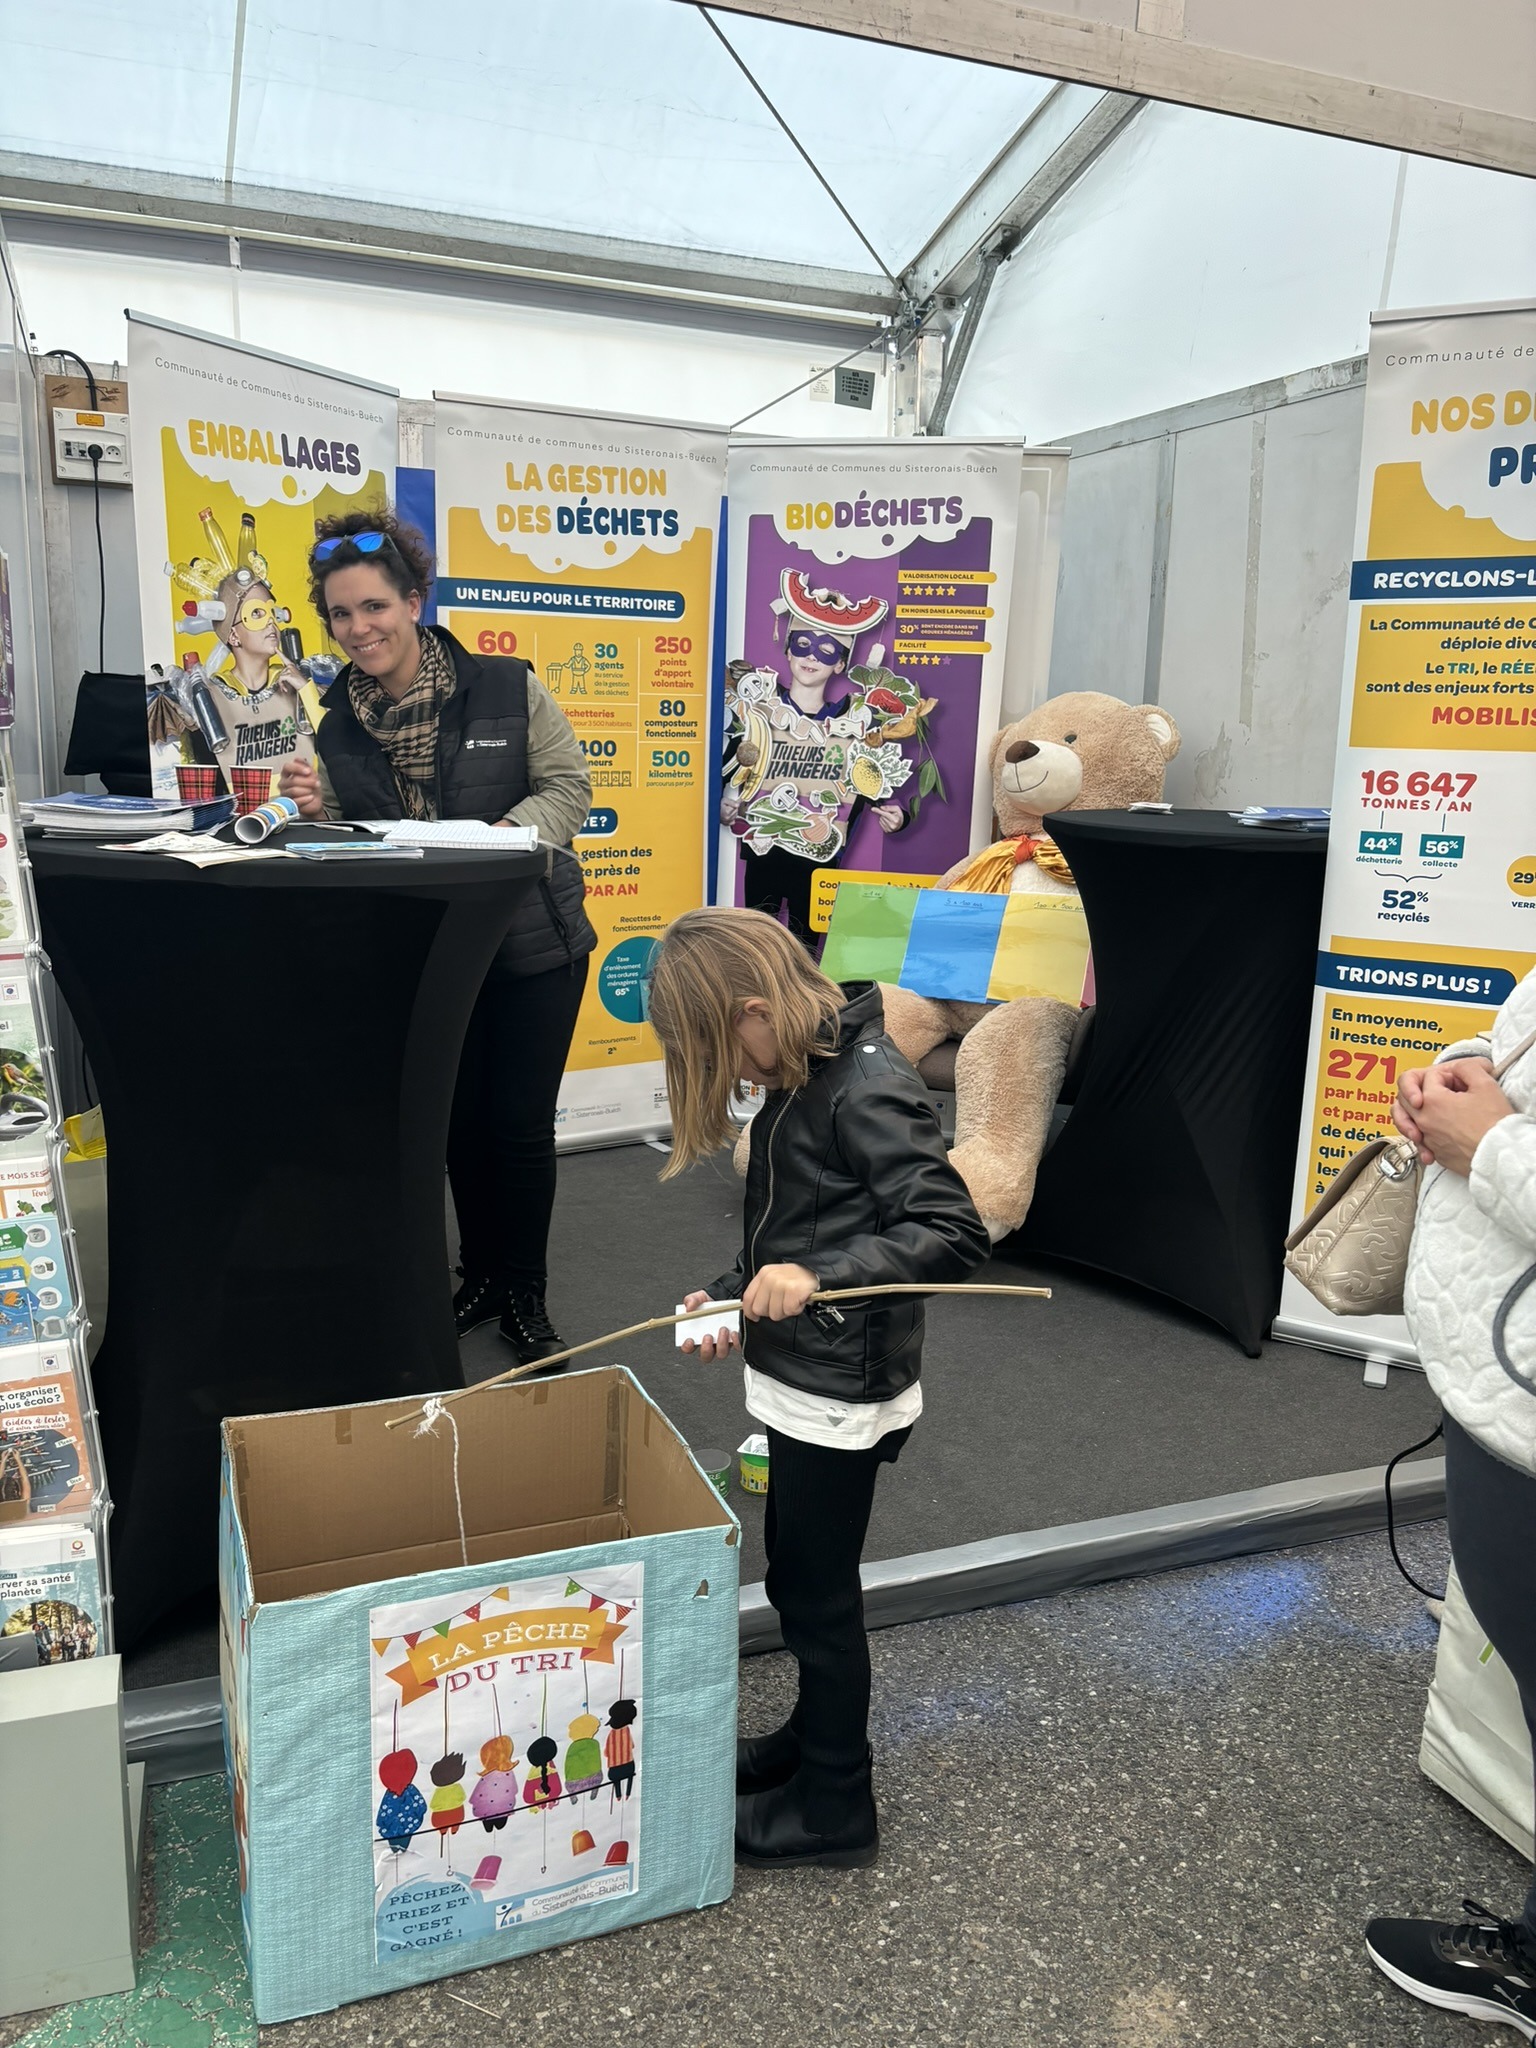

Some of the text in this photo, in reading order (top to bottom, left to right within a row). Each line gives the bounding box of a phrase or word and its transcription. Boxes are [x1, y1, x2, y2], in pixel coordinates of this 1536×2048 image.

[1385, 345, 1534, 367] Communauté de
[154, 357, 384, 424] Communauté de Communes du Sisteronais-Buëch
[1411, 393, 1496, 435] NOS
[188, 418, 361, 476] EMBALLAGES
[447, 427, 717, 464] Communauté de communes du Sisteronais-Buëch
[750, 464, 998, 474] Communauté de Communes du Sisteronais-Buëch
[505, 461, 667, 497] LA GESTION
[496, 496, 679, 537] DES DÉCHETS
[786, 490, 963, 531] BIODÉCHETS
[456, 587, 676, 612] UN ENJEU POUR LE TERRITOIRE
[900, 625, 919, 634] 30%
[1370, 617, 1525, 631] La Communauté de
[477, 630, 517, 655] 60
[654, 636, 692, 655] 250
[1441, 637, 1502, 652] déploie
[594, 643, 618, 659] 30
[594, 662, 625, 671] agents
[660, 659, 687, 667] points
[1426, 659, 1536, 676] Le TRI, le RÉE
[654, 669, 692, 679] d'apport
[651, 680, 694, 689] volontaire
[1366, 681, 1534, 696] sont des enjeux forts
[660, 700, 686, 716] 80
[645, 720, 698, 728] composteurs
[235, 720, 282, 746] TRIEURS
[646, 730, 697, 738] fonctionnels
[236, 735, 297, 766] RANGERS
[772, 740, 826, 763] TRIEURS
[652, 751, 690, 767] 500
[649, 770, 693, 778] kilomètres
[766, 763, 844, 781] RANGERS
[1361, 770, 1478, 799] 16 647
[1361, 798, 1472, 813] TONNES AN
[582, 847, 652, 862] gestion des
[1364, 838, 1459, 855] 44% 56%
[1356, 855, 1458, 869] déchetterie collecte
[595, 865, 623, 879] près
[625, 865, 640, 876] de
[1513, 872, 1536, 884] 29
[585, 884, 638, 897] PAR AN
[1382, 890, 1429, 910] 52%
[818, 913, 826, 921] le
[1377, 911, 1431, 924] recyclés
[607, 979, 638, 987] ménagères
[1336, 966, 1492, 995] TRIONS PLUS !
[615, 988, 630, 996] 65%
[1332, 1008, 1443, 1033] En moyenne,
[588, 1035, 637, 1046] Remboursements
[1330, 1027, 1340, 1041] il
[1343, 1030, 1388, 1045] reste
[1327, 1049, 1397, 1085] 271
[1324, 1086, 1397, 1105] par habi
[1322, 1106, 1373, 1123] et par
[1321, 1124, 1342, 1138] de
[1319, 1146, 1346, 1160] qui
[1315, 1182, 1325, 1194] à
[8, 1387, 58, 1400] organiser
[24, 1396, 52, 1407] écolo
[41, 1573, 72, 1585] santé
[1, 1587, 42, 1600] planète
[429, 1622, 590, 1672] LA PÊCHE
[447, 1652, 575, 1693] DU TRI
[390, 1883, 467, 1907] PÊCHEZ,
[532, 1873, 629, 1907] Communauté de Communes
[532, 1881, 629, 1917] du Sisteronais-Buëch
[386, 1897, 470, 1923] TRIEZ ET
[402, 1916, 454, 1935] C'EST
[390, 1930, 455, 1953] GAGNÉ
